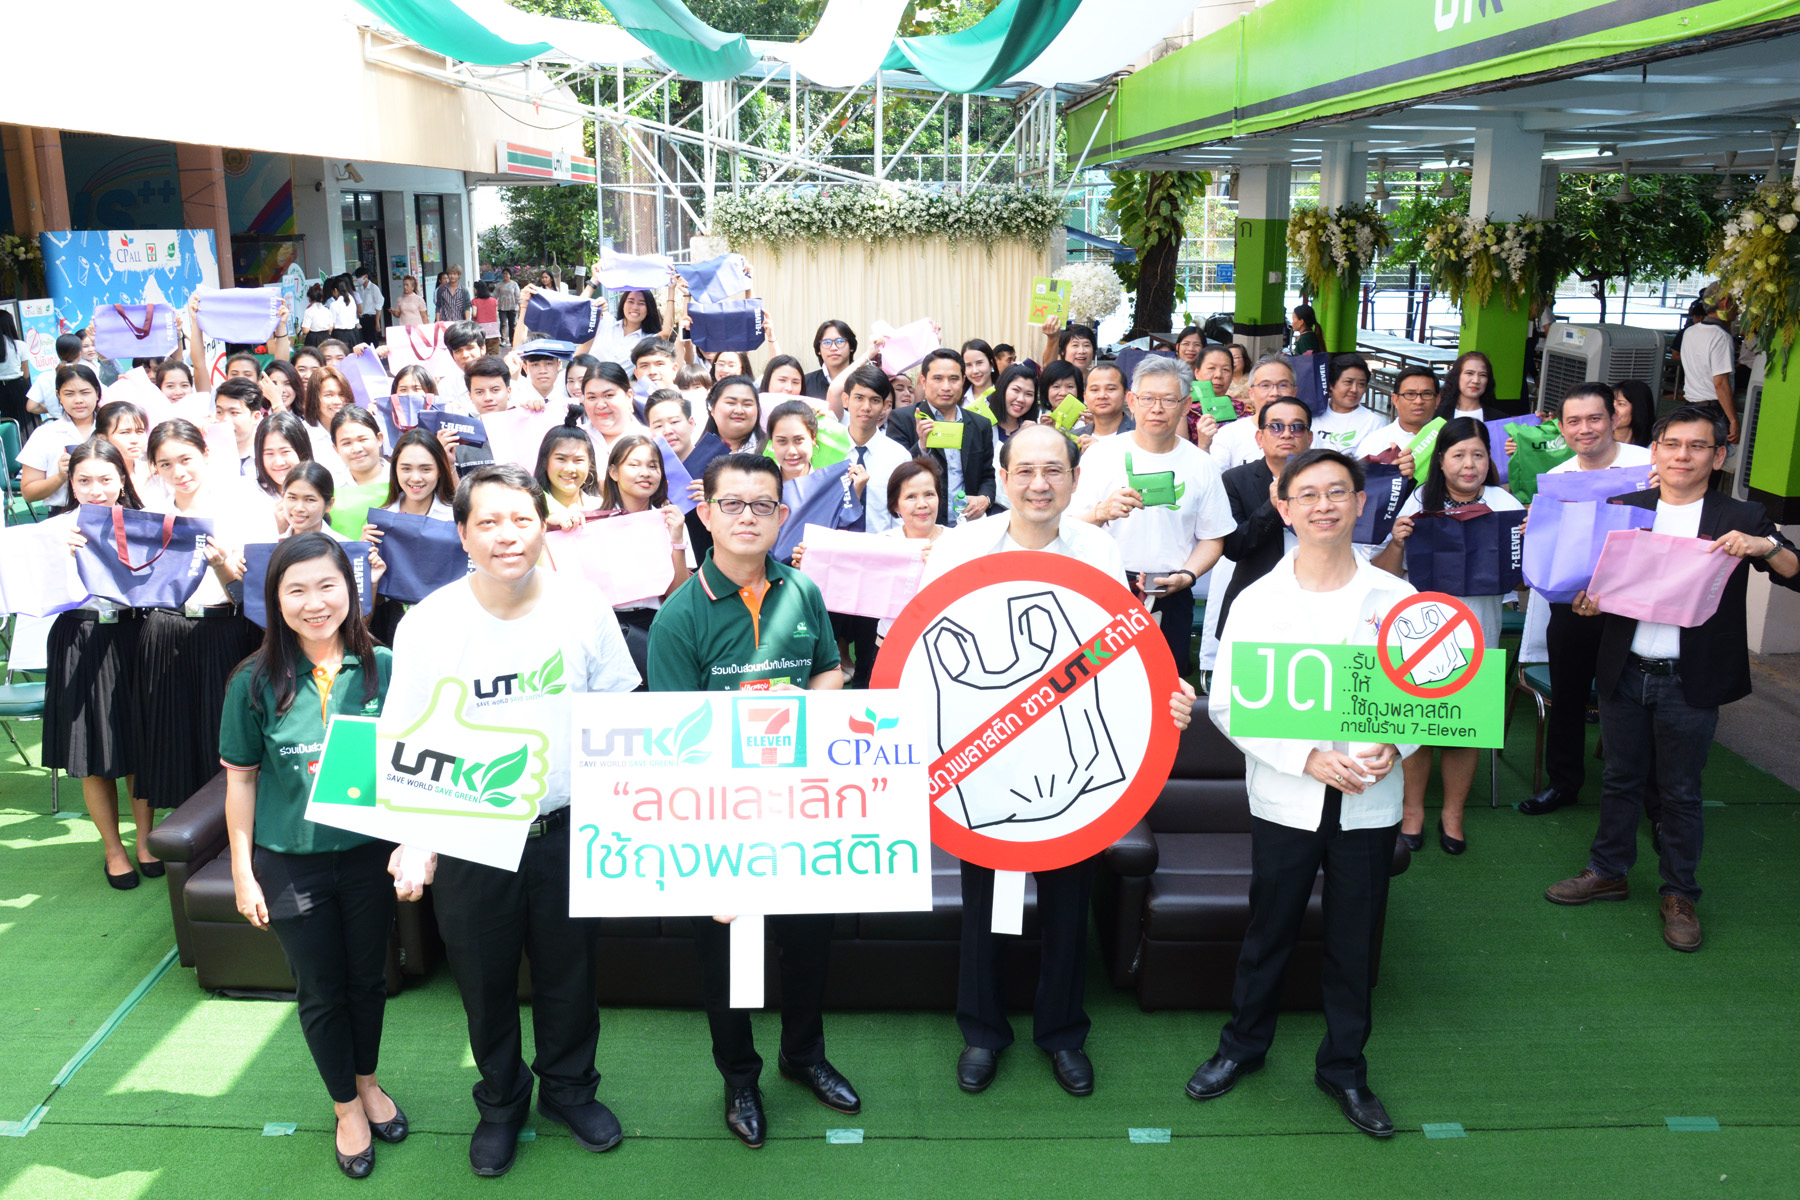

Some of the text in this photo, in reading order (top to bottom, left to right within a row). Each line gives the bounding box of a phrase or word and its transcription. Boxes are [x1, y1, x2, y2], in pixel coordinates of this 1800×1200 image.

[474, 670, 540, 699] UTK
[1231, 647, 1333, 712] งด
[581, 728, 674, 757] UTK
[1411, 722, 1477, 738] 7-Eleven
[391, 741, 486, 793] UTK
[386, 773, 479, 803] SAVE WORLD SAVE GREEN
[579, 823, 919, 891] ใช้ถุงพลาสติก
